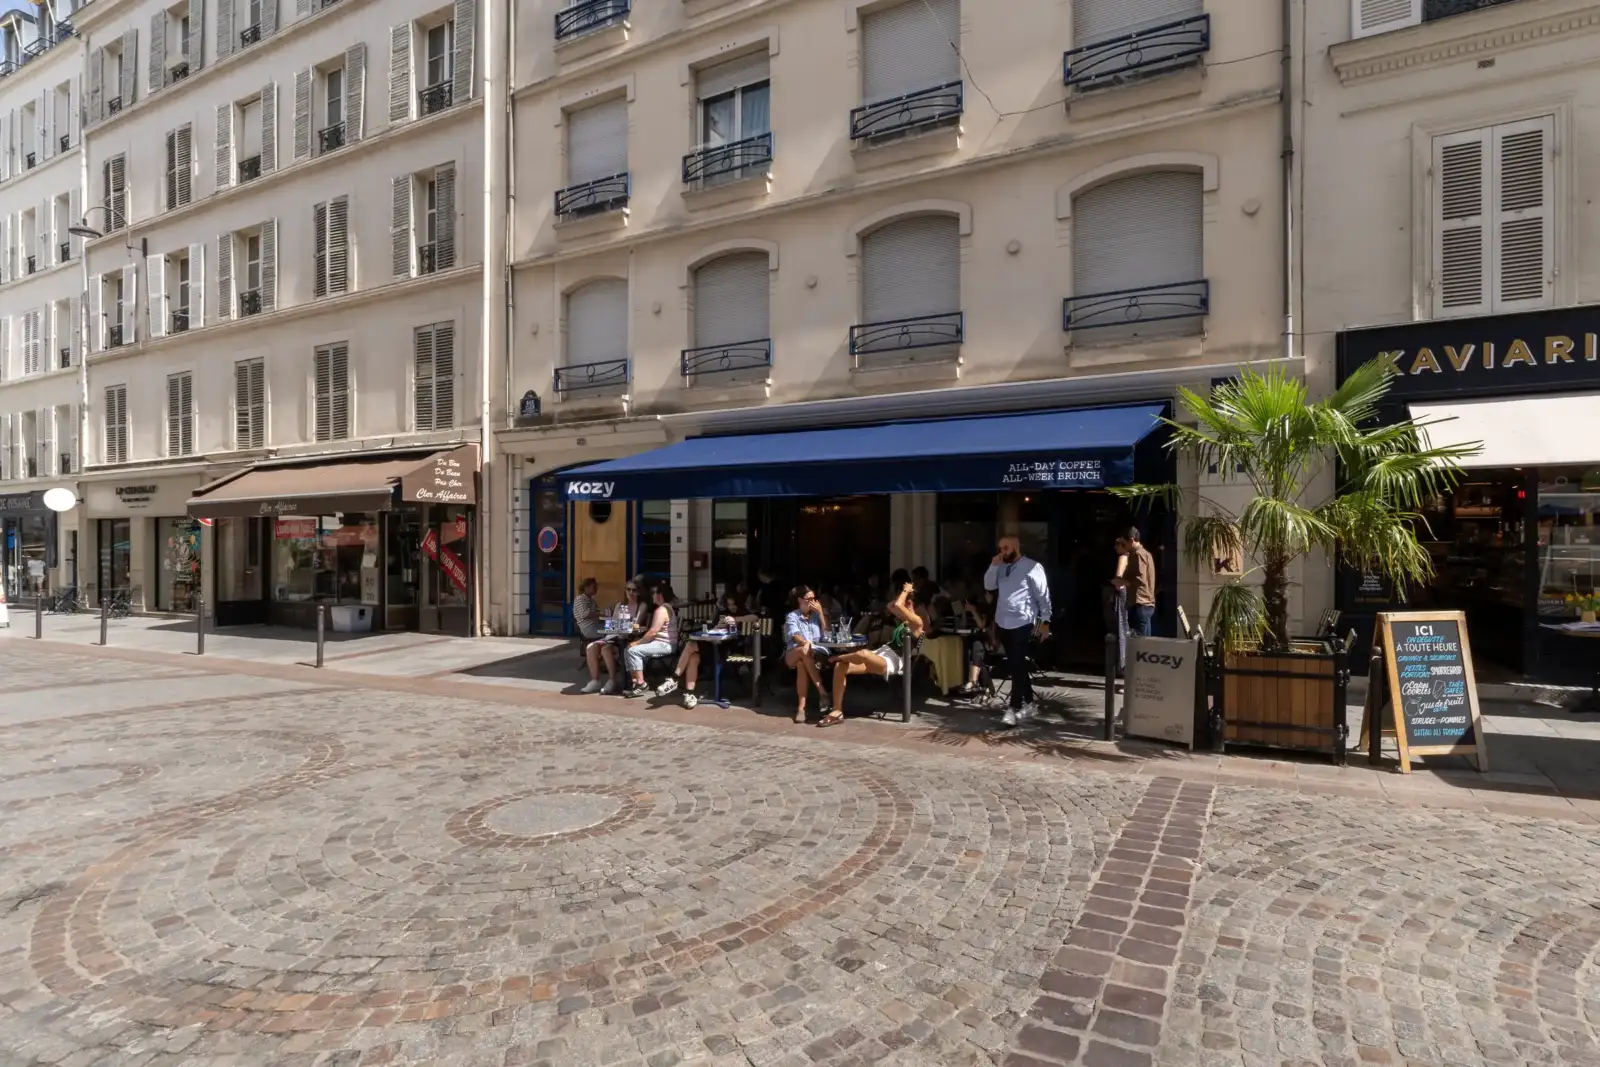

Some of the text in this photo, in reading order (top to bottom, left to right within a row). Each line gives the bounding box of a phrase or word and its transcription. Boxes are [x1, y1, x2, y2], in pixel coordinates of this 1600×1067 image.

[1377, 333, 1597, 376] KAVIARI
[1009, 460, 1101, 472] ALL-DAY COFFEE
[1002, 471, 1100, 483] ALL-WEEK BRUNCH
[416, 488, 467, 501] Cler Affaires
[568, 481, 615, 498] Kozy
[1415, 625, 1434, 636] ICI
[1404, 643, 1431, 652] TOUTE
[1432, 643, 1458, 651] HEURE
[1136, 651, 1183, 669] Kozy
[1440, 716, 1466, 724] POMMES
